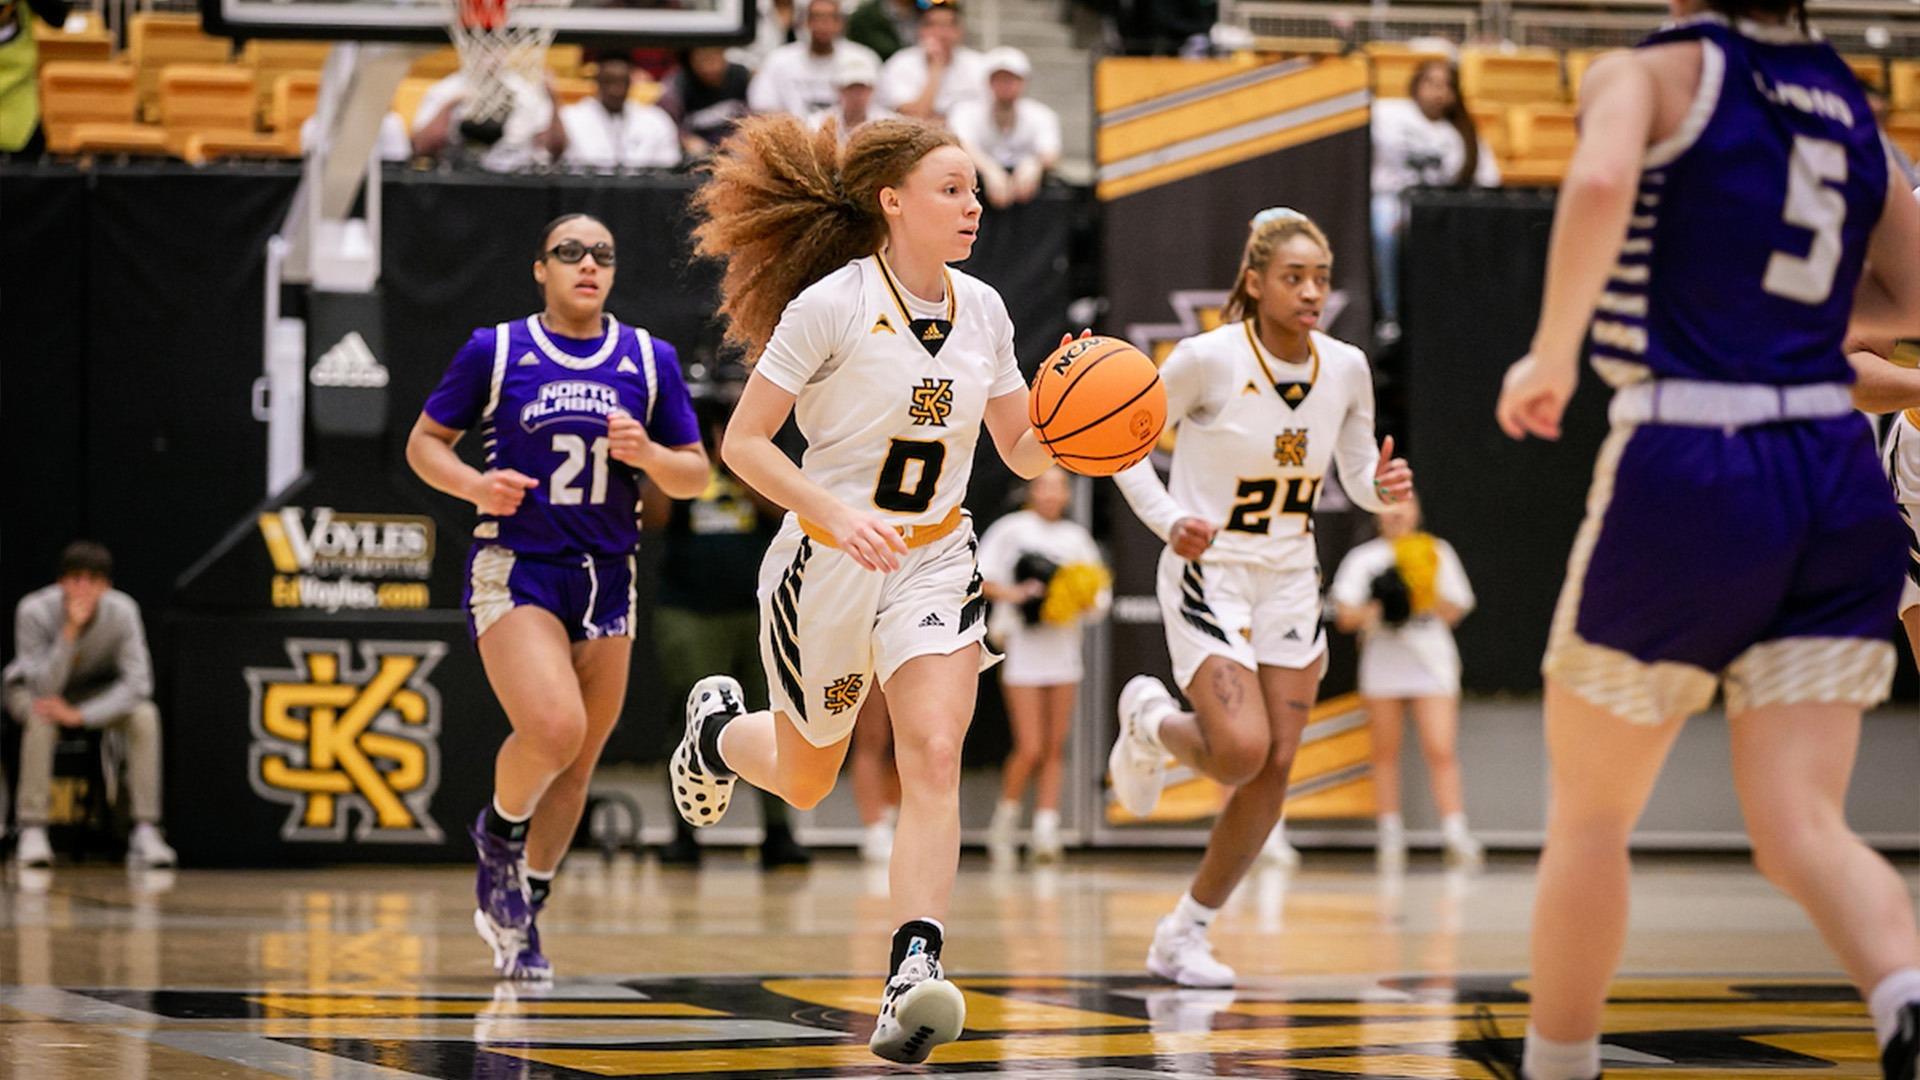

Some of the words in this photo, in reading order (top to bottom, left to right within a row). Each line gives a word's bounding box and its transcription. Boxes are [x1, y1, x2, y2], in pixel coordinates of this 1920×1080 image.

[1762, 133, 1848, 304] 5
[541, 383, 617, 405] NORTH
[549, 433, 610, 505] 21
[870, 435, 947, 516] 0
[1225, 475, 1322, 535] 24
[279, 506, 428, 568] VOYLES
[271, 574, 430, 613] EdVoyles.com
